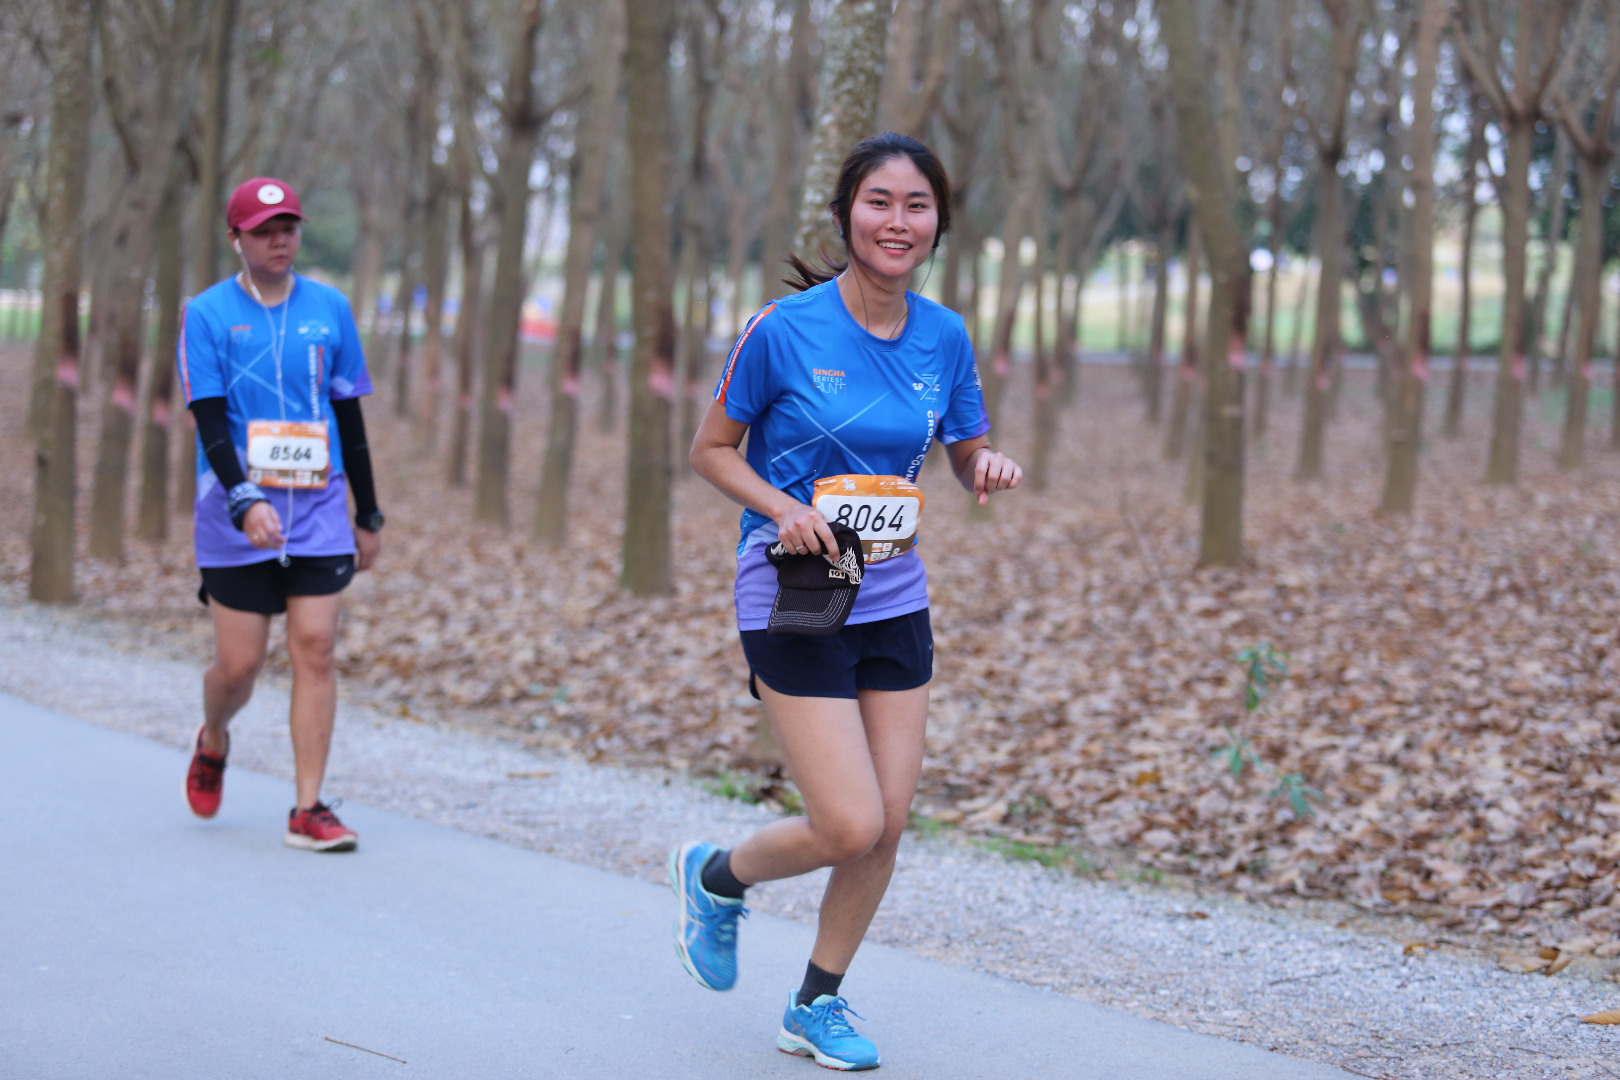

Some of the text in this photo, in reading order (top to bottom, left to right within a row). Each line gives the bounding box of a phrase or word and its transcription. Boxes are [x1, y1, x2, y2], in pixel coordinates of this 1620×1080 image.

[812, 368, 846, 377] SINGHA
[270, 446, 312, 461] 8564
[835, 503, 905, 533] 8064
[830, 570, 845, 578] 101
